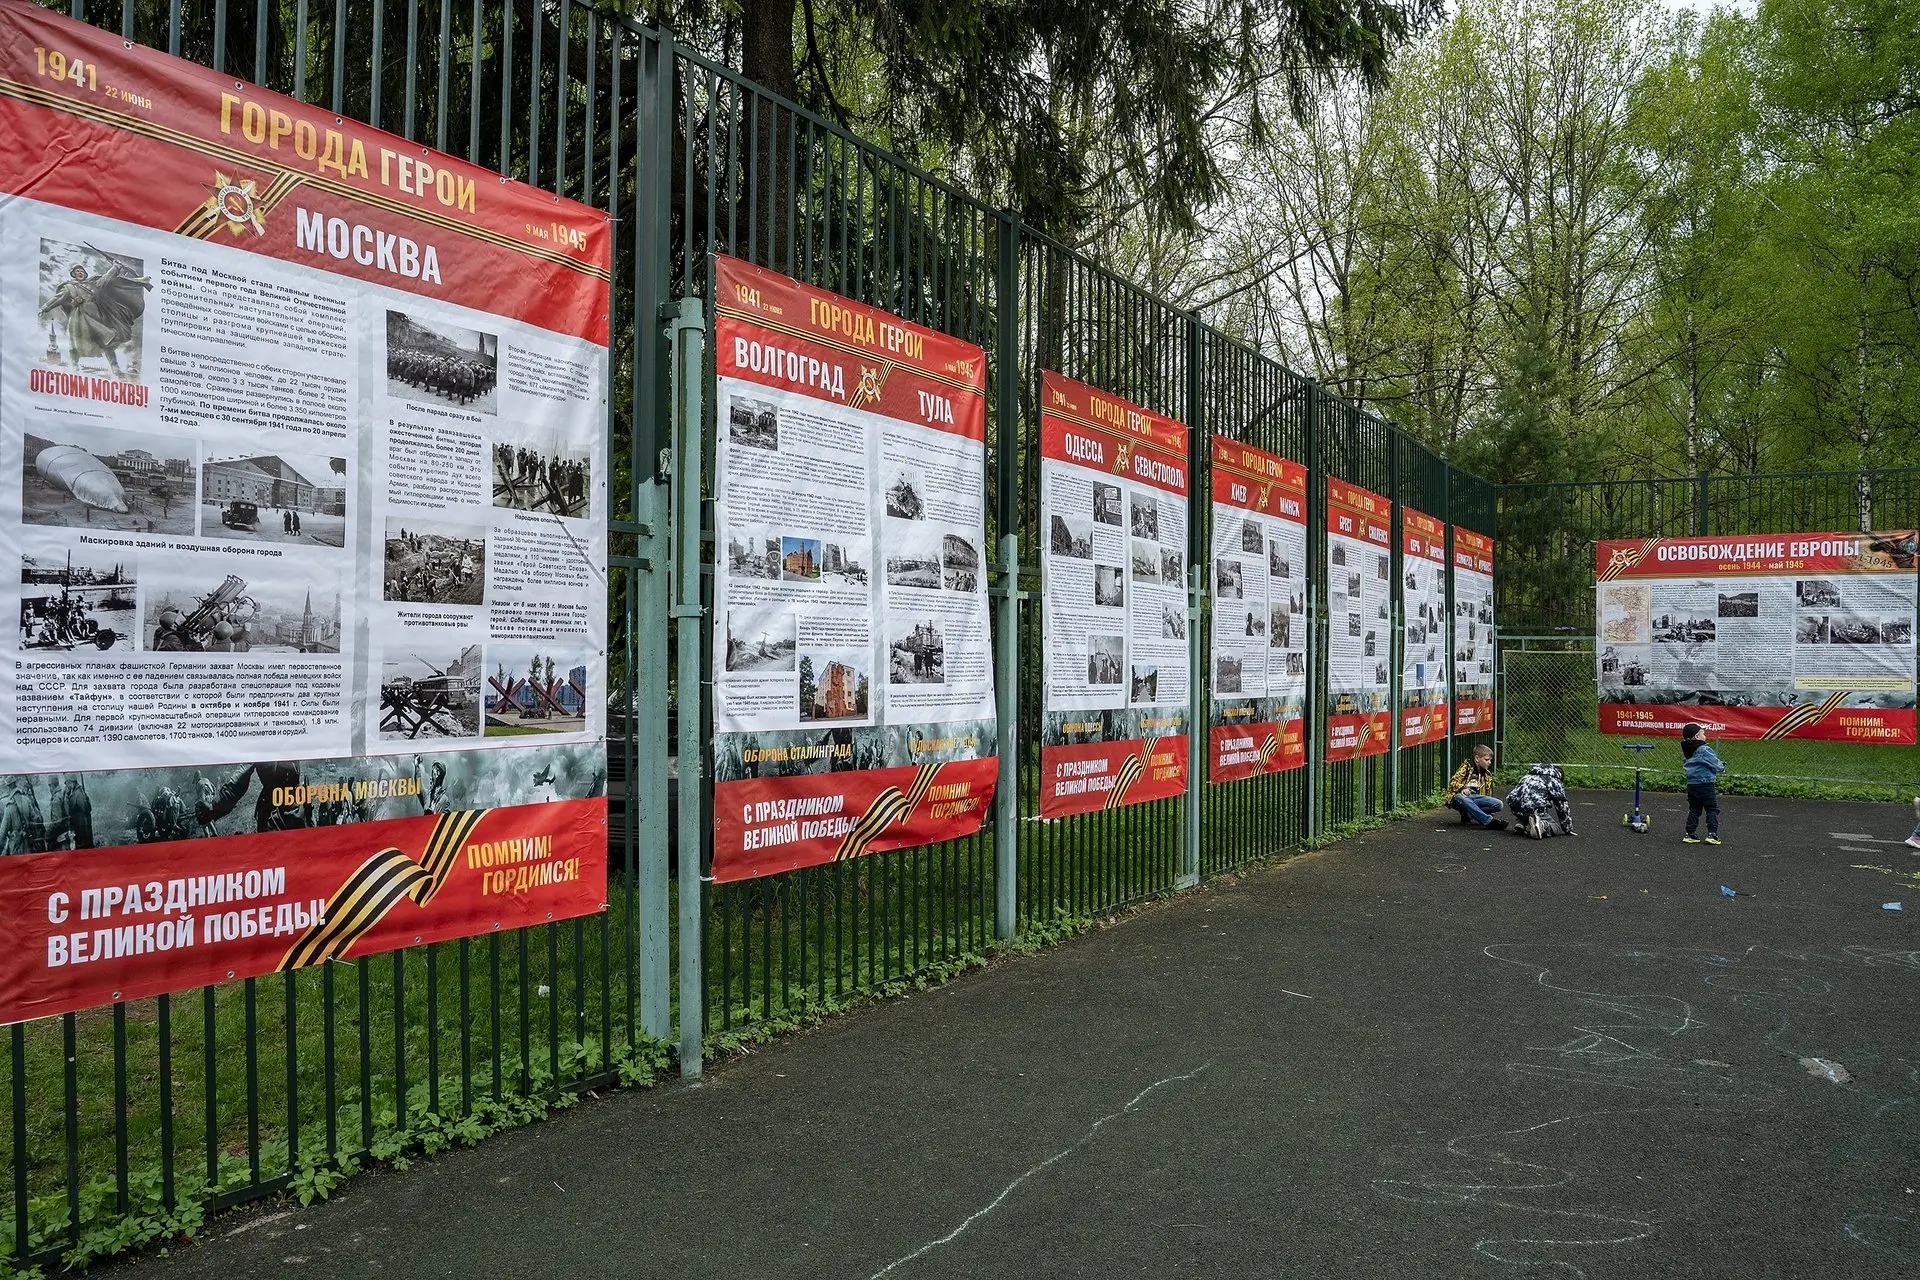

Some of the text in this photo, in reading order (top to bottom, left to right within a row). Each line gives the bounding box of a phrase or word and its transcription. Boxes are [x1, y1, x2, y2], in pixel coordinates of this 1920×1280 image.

[33, 46, 152, 110] 1941 22 ИЮНЯ
[220, 91, 476, 214] ГОРОДА ГЕРОИ
[296, 207, 442, 285] МОСКВА
[525, 221, 587, 252] 9 МАЯ 1945
[160, 278, 195, 290] войны.
[160, 269, 346, 314] событием первого года Великой Отечественной
[161, 257, 346, 305] Битва под Москвой стала главным военным
[735, 284, 760, 308] 1941
[810, 297, 923, 361] ГОРОДА ГЕРОИ
[734, 337, 846, 400] ВОЛГОГРАД
[956, 360, 974, 379] 1945
[30, 368, 149, 409] ОТСТОИМ МОСКВУ!
[1052, 390, 1066, 407] 1941
[406, 403, 425, 412] После
[426, 408, 448, 416] парада
[448, 412, 465, 420] сразу
[918, 389, 954, 425] ТУЛА
[1090, 395, 1152, 437] ГОРОДА ГЕРОИ
[398, 421, 434, 433] результате
[438, 429, 481, 440] завязавшейся
[1065, 432, 1104, 464] ОДЕССА
[1134, 454, 1184, 488] СЕВАСТОПОЛЬ
[1242, 451, 1283, 479] ГОРОДА ГЕРОИ
[1231, 482, 1247, 503] КИЕВ
[1280, 497, 1300, 517] МИНСК
[79, 535, 134, 546] Маскировка
[135, 540, 166, 548] зданий
[175, 543, 220, 552] воздушная
[221, 545, 255, 554] оборона
[1657, 540, 1860, 562] ОСВОБОЖДЕНИЕ ЕВРОПЫ
[1742, 562, 1761, 570] 1944
[1768, 560, 1784, 569] май
[1785, 560, 1804, 569] 1945
[443, 613, 473, 621] сооружают
[26, 662, 81, 670] агрессивных
[119, 662, 165, 670] фашисткой
[169, 662, 206, 670] Германии
[15, 704, 74, 714] наступления
[127, 702, 154, 710] нашей
[198, 701, 231, 709] октябре
[242, 700, 270, 709] ноябре
[69, 692, 115, 701] «Тайфун»,
[192, 691, 222, 700] которой
[248, 692, 294, 700] предприняты
[297, 691, 310, 700] два
[313, 691, 340, 700] крупных
[1616, 710, 1654, 720] 1941-1945
[1622, 721, 1664, 729] ПРАЗДНИКОМ
[1840, 717, 1884, 727] ПОМНИМ!
[1846, 727, 1900, 738] ГОРДИМСЯ!
[744, 743, 852, 763] ОБОРОНА СТАЛИНГРАДА
[1056, 758, 1108, 778] С ПРАЗДНИКОМ
[271, 777, 422, 808] ОБОРОНА МОСКВЫ
[928, 782, 971, 802] ПОМНИМ!
[1055, 777, 1087, 796] ВЕЛИКОЙ
[743, 794, 844, 825] С ПРАЗДНИКОМ
[743, 816, 860, 851] ВЕЛИКОЙ ПОБЕДЫ!
[466, 834, 552, 870] ПОМНИМ!
[482, 857, 580, 898] ГОРДИМСЯ!
[47, 867, 285, 925] С ПРАЗДНИКОМ
[47, 898, 326, 968] ВЕЛИКОЙ ПОБЕДЫ!
